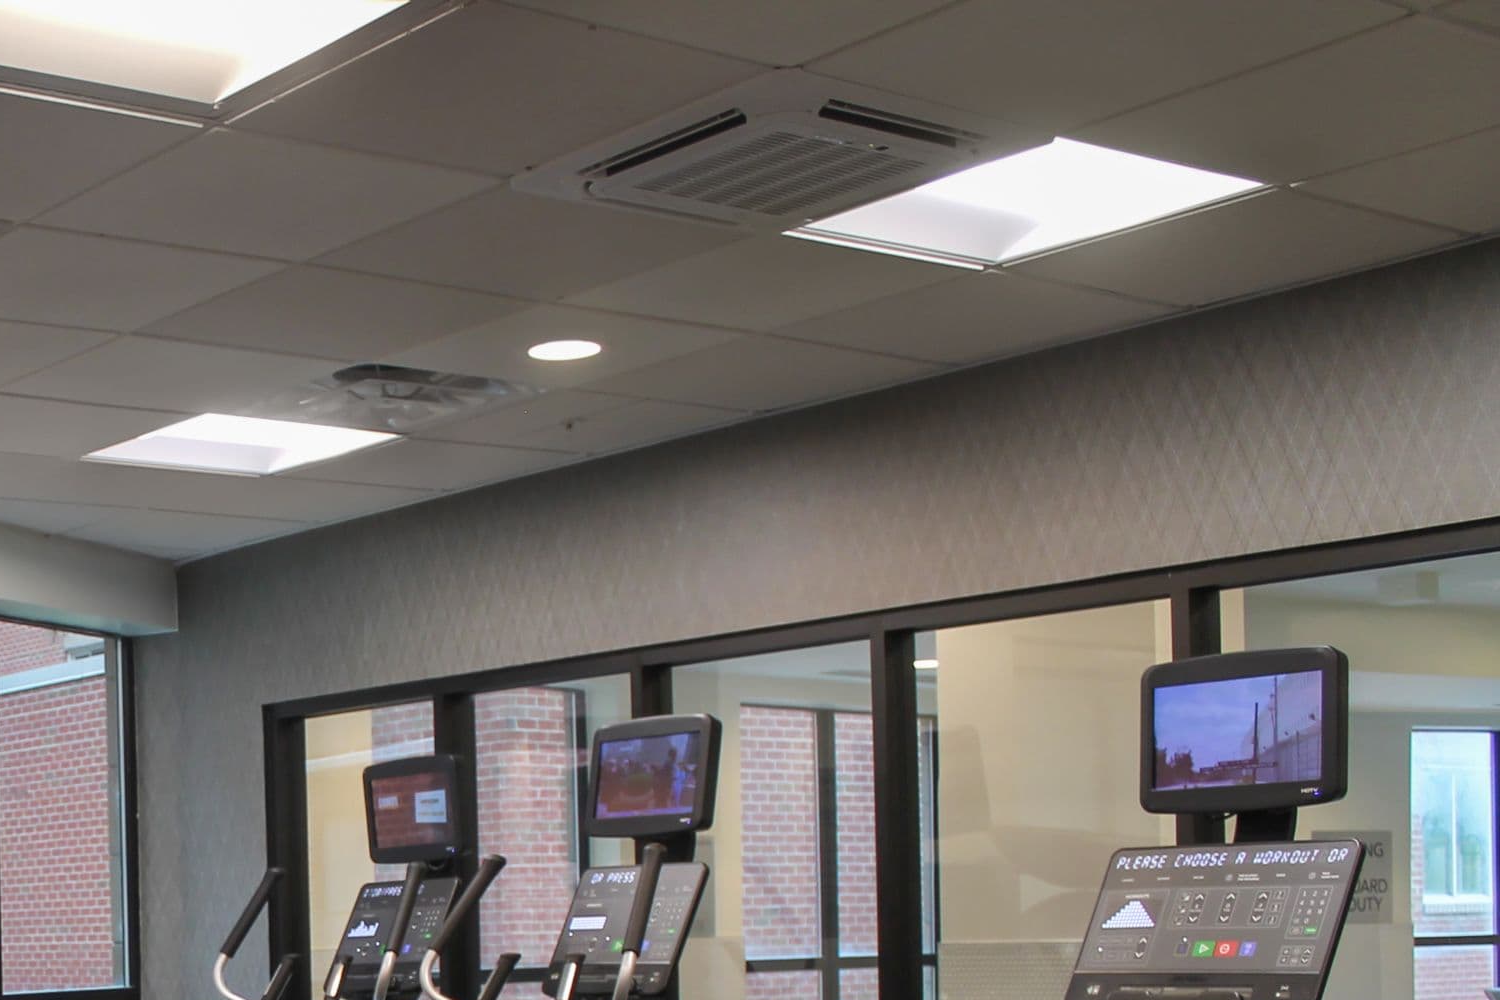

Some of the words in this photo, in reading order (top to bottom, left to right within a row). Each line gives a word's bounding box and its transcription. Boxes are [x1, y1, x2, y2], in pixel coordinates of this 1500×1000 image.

[1116, 855, 1167, 870] PLEASE
[1174, 852, 1228, 868] CHOOSE
[1235, 853, 1247, 865] A
[1253, 849, 1320, 864] WORKOUT
[1327, 848, 1349, 863] OR
[607, 871, 636, 884] PRESS
